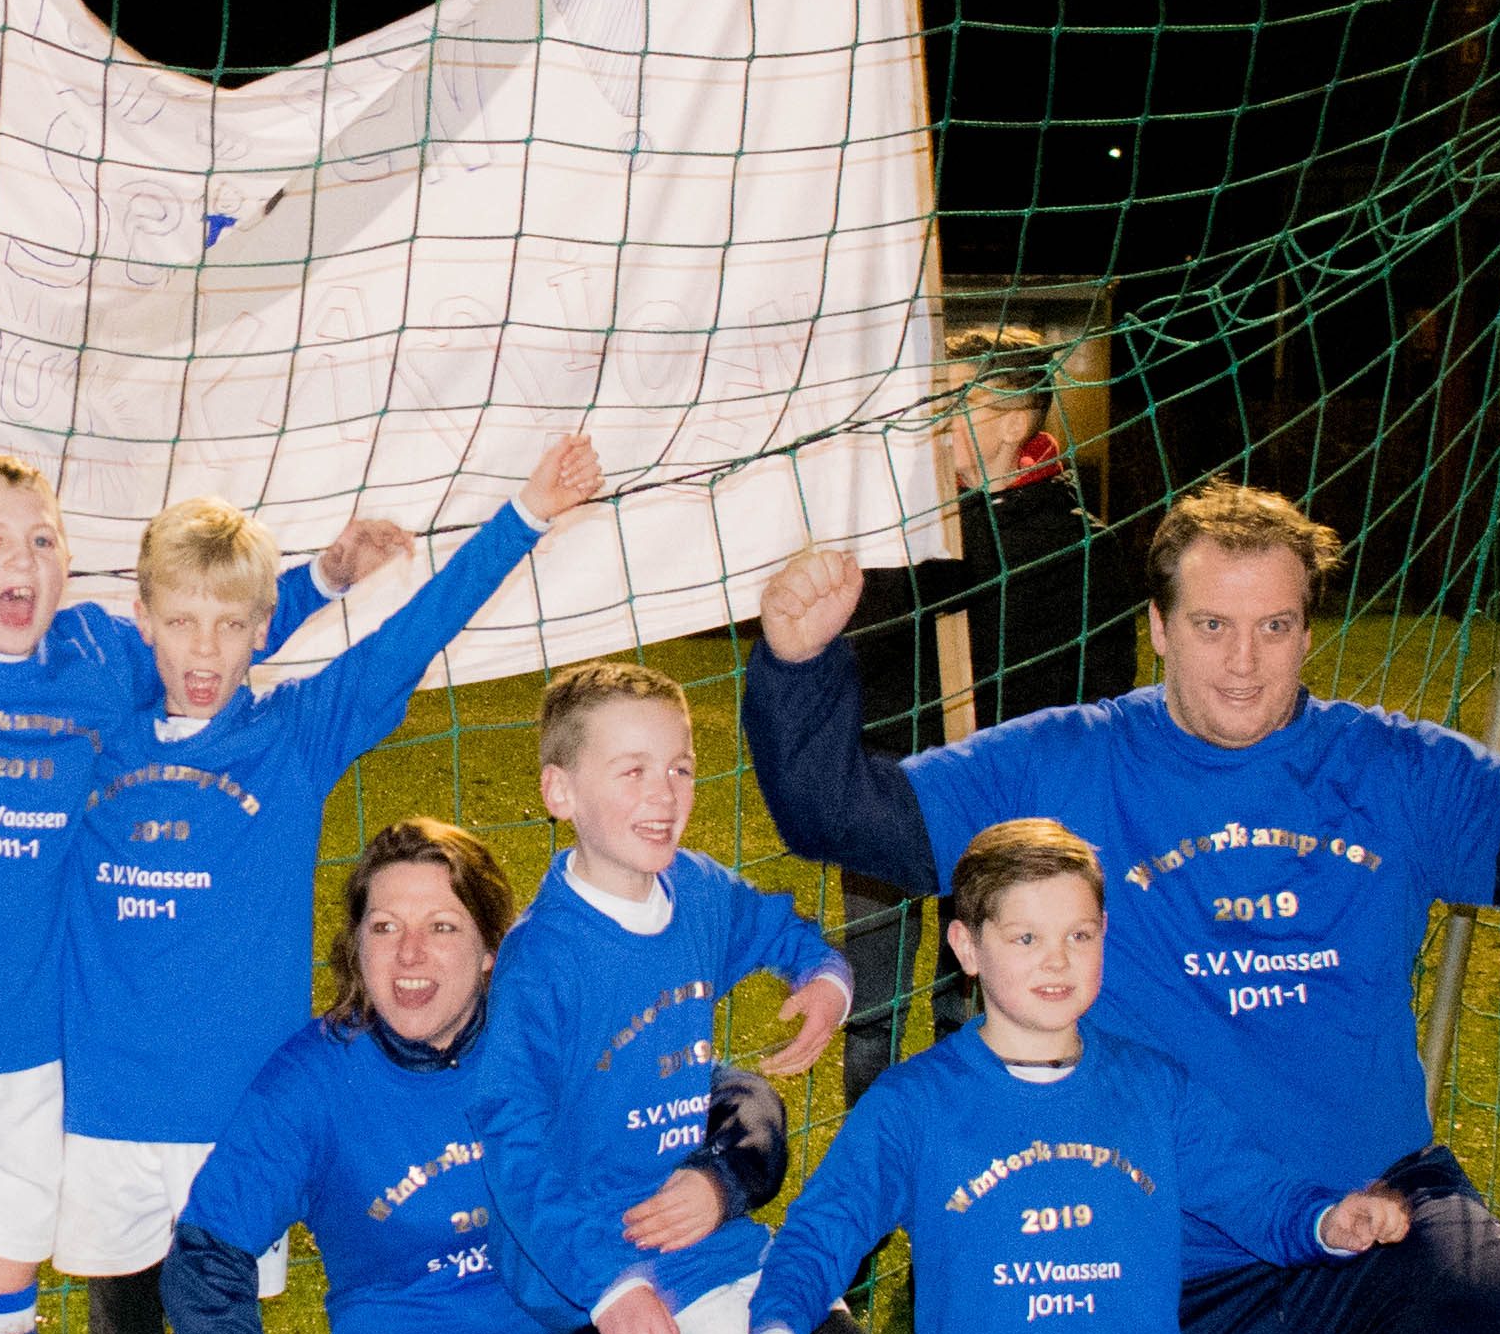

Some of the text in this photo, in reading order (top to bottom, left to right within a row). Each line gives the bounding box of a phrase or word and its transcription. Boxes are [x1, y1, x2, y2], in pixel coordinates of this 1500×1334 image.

[117, 896, 176, 921] JO11-1
[1212, 890, 1299, 922] 2019
[1228, 983, 1307, 1015] JO11-1
[1021, 1203, 1094, 1234] 2019
[1026, 1293, 1096, 1323] JO11-1
